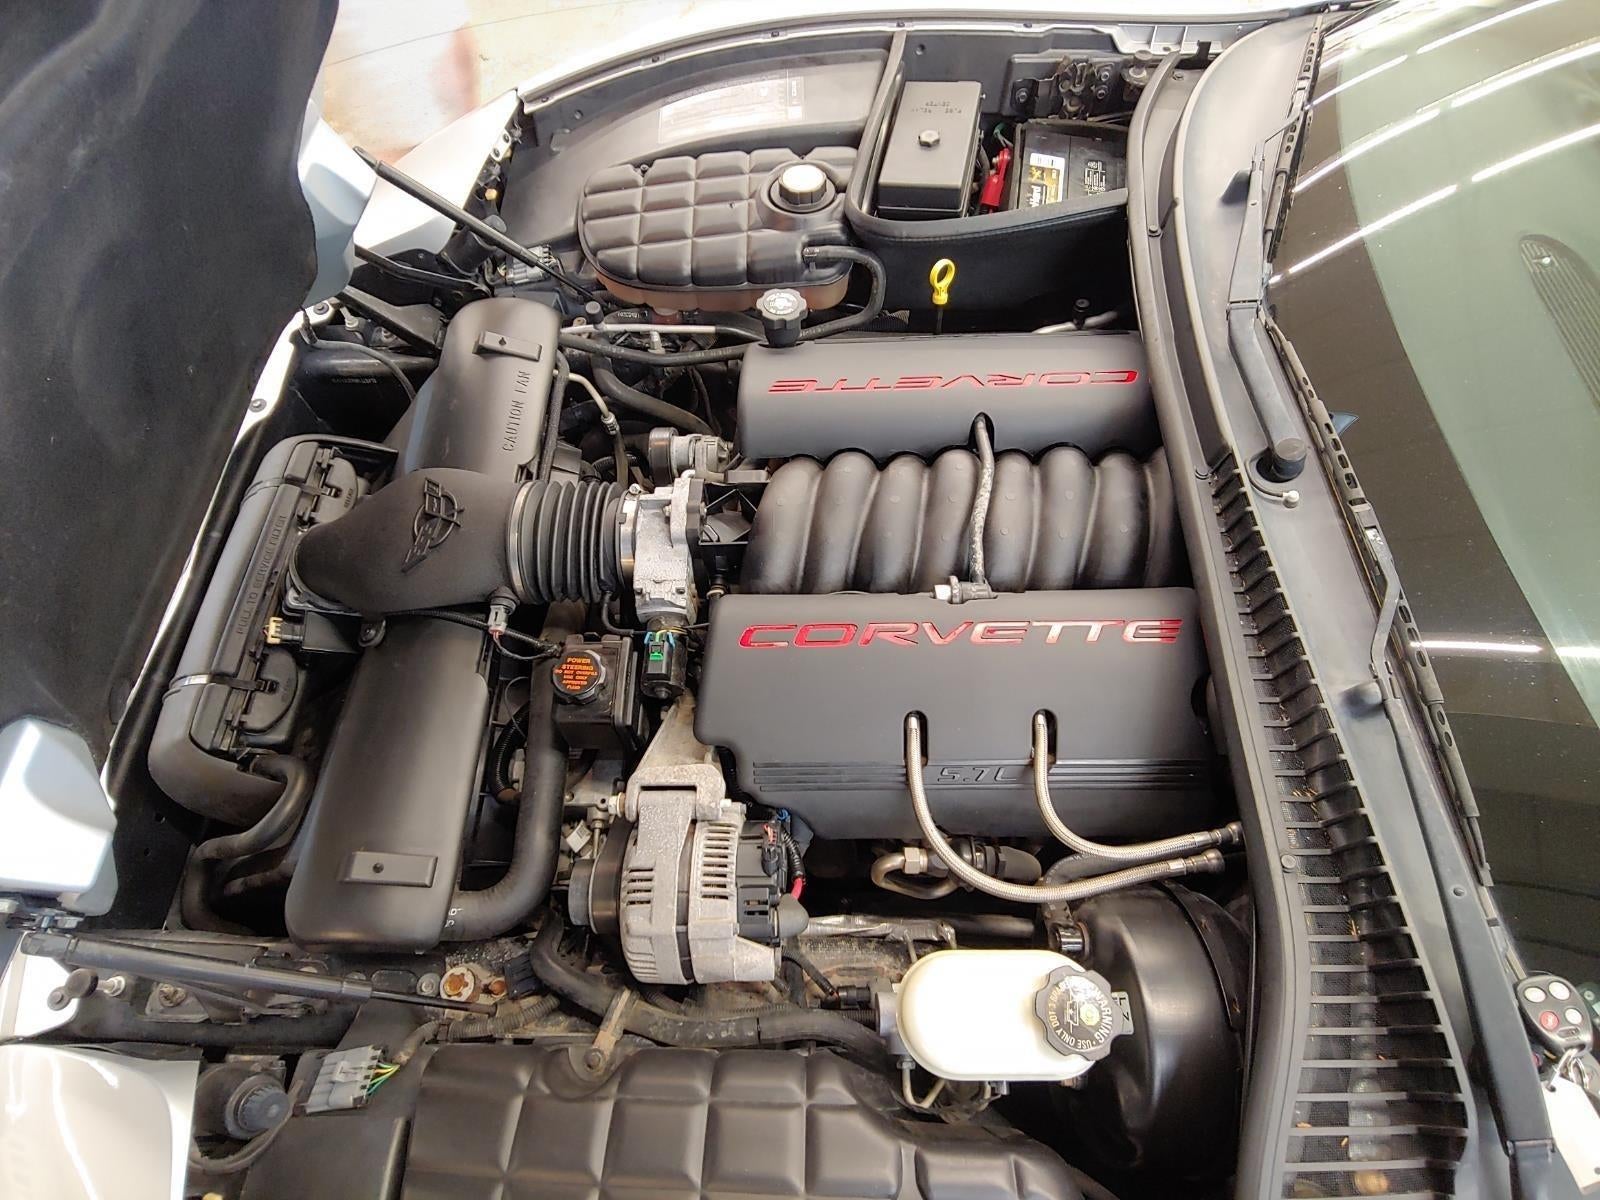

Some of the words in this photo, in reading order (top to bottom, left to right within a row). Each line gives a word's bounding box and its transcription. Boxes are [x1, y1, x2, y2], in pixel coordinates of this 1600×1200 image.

[768, 370, 1139, 393] CORVETTE
[502, 400, 525, 452] CAUTION
[738, 618, 1182, 649] CORVETTE
[937, 766, 1018, 783] 5.7L
[1048, 1010, 1060, 1029] DOT
[1092, 985, 1113, 1043] WARNING
[1056, 1028, 1076, 1047] ONLY
[1077, 1039, 1093, 1050] USE
